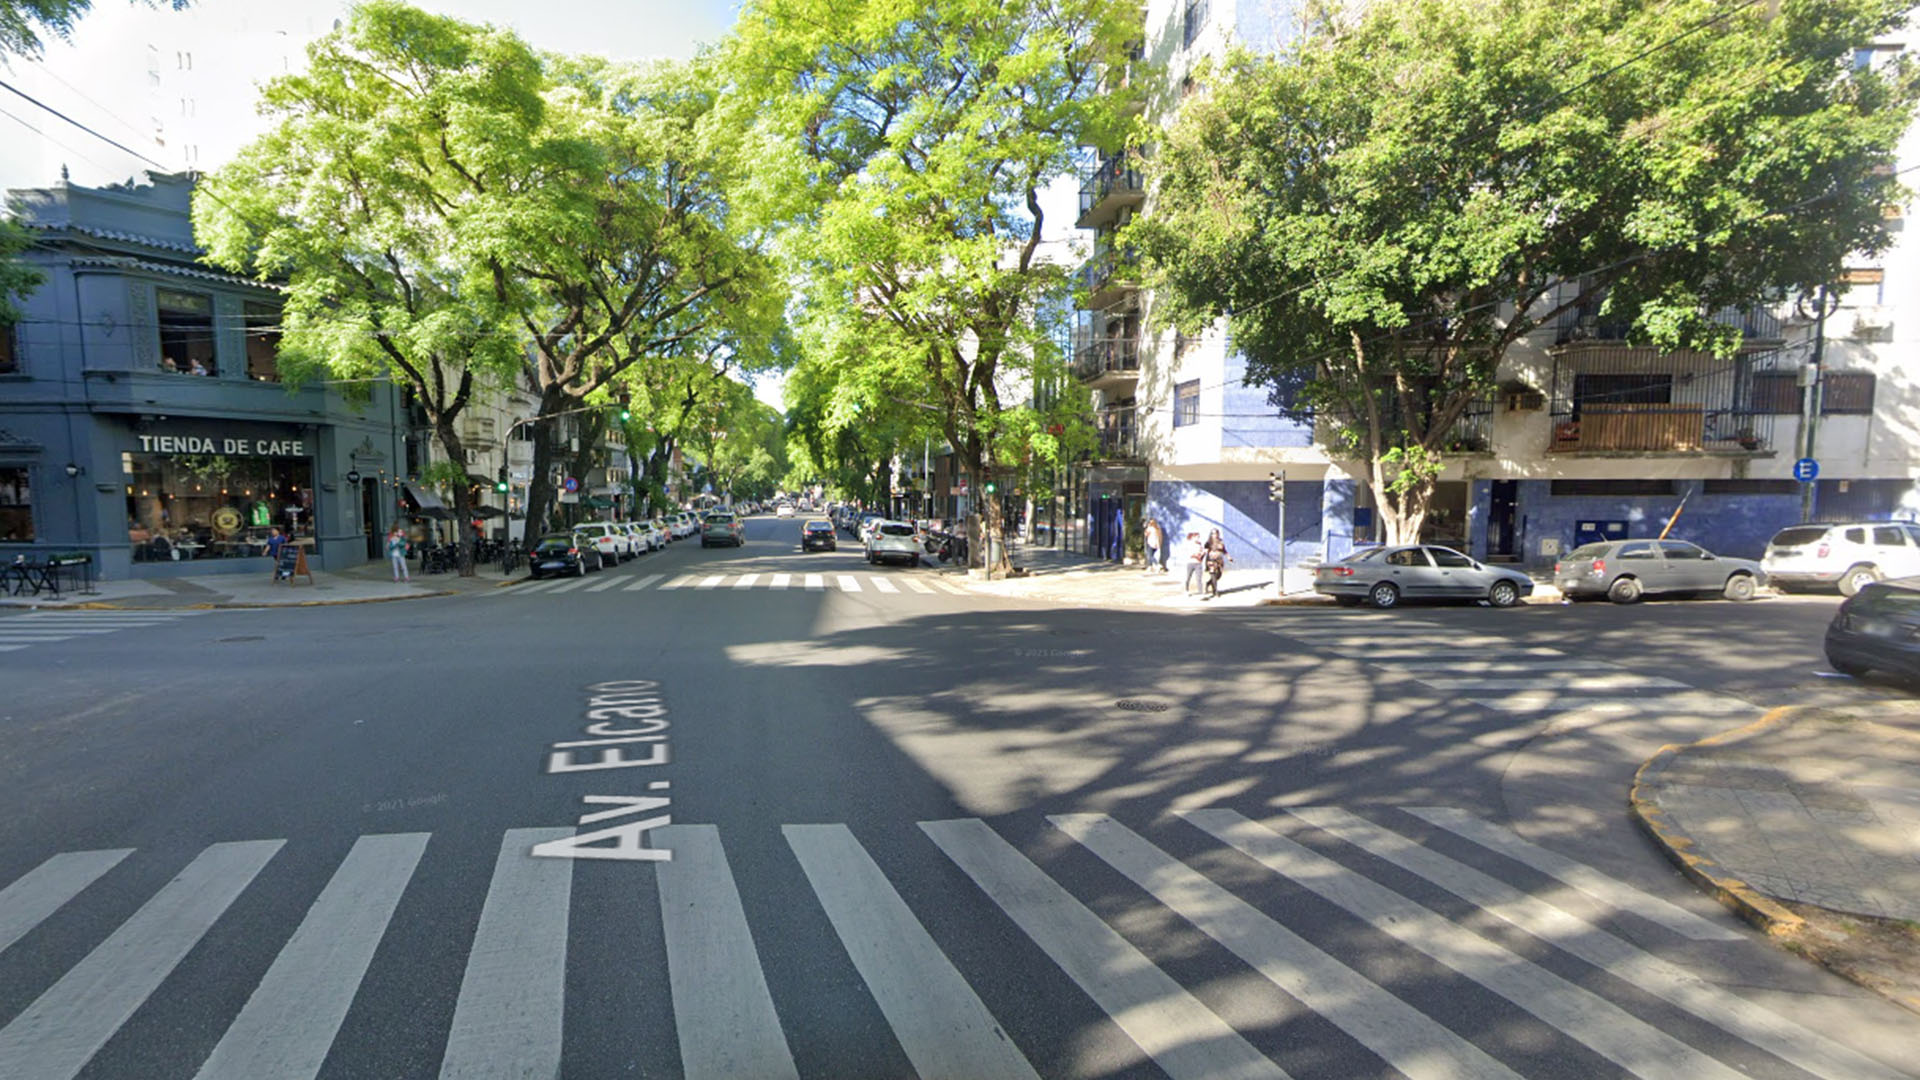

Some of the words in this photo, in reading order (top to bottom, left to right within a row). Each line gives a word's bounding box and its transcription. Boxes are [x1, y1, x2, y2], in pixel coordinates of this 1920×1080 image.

[138, 434, 216, 454] TIENDA
[223, 438, 250, 455] DE
[256, 440, 304, 456] CAFE
[1799, 461, 1812, 478] E
